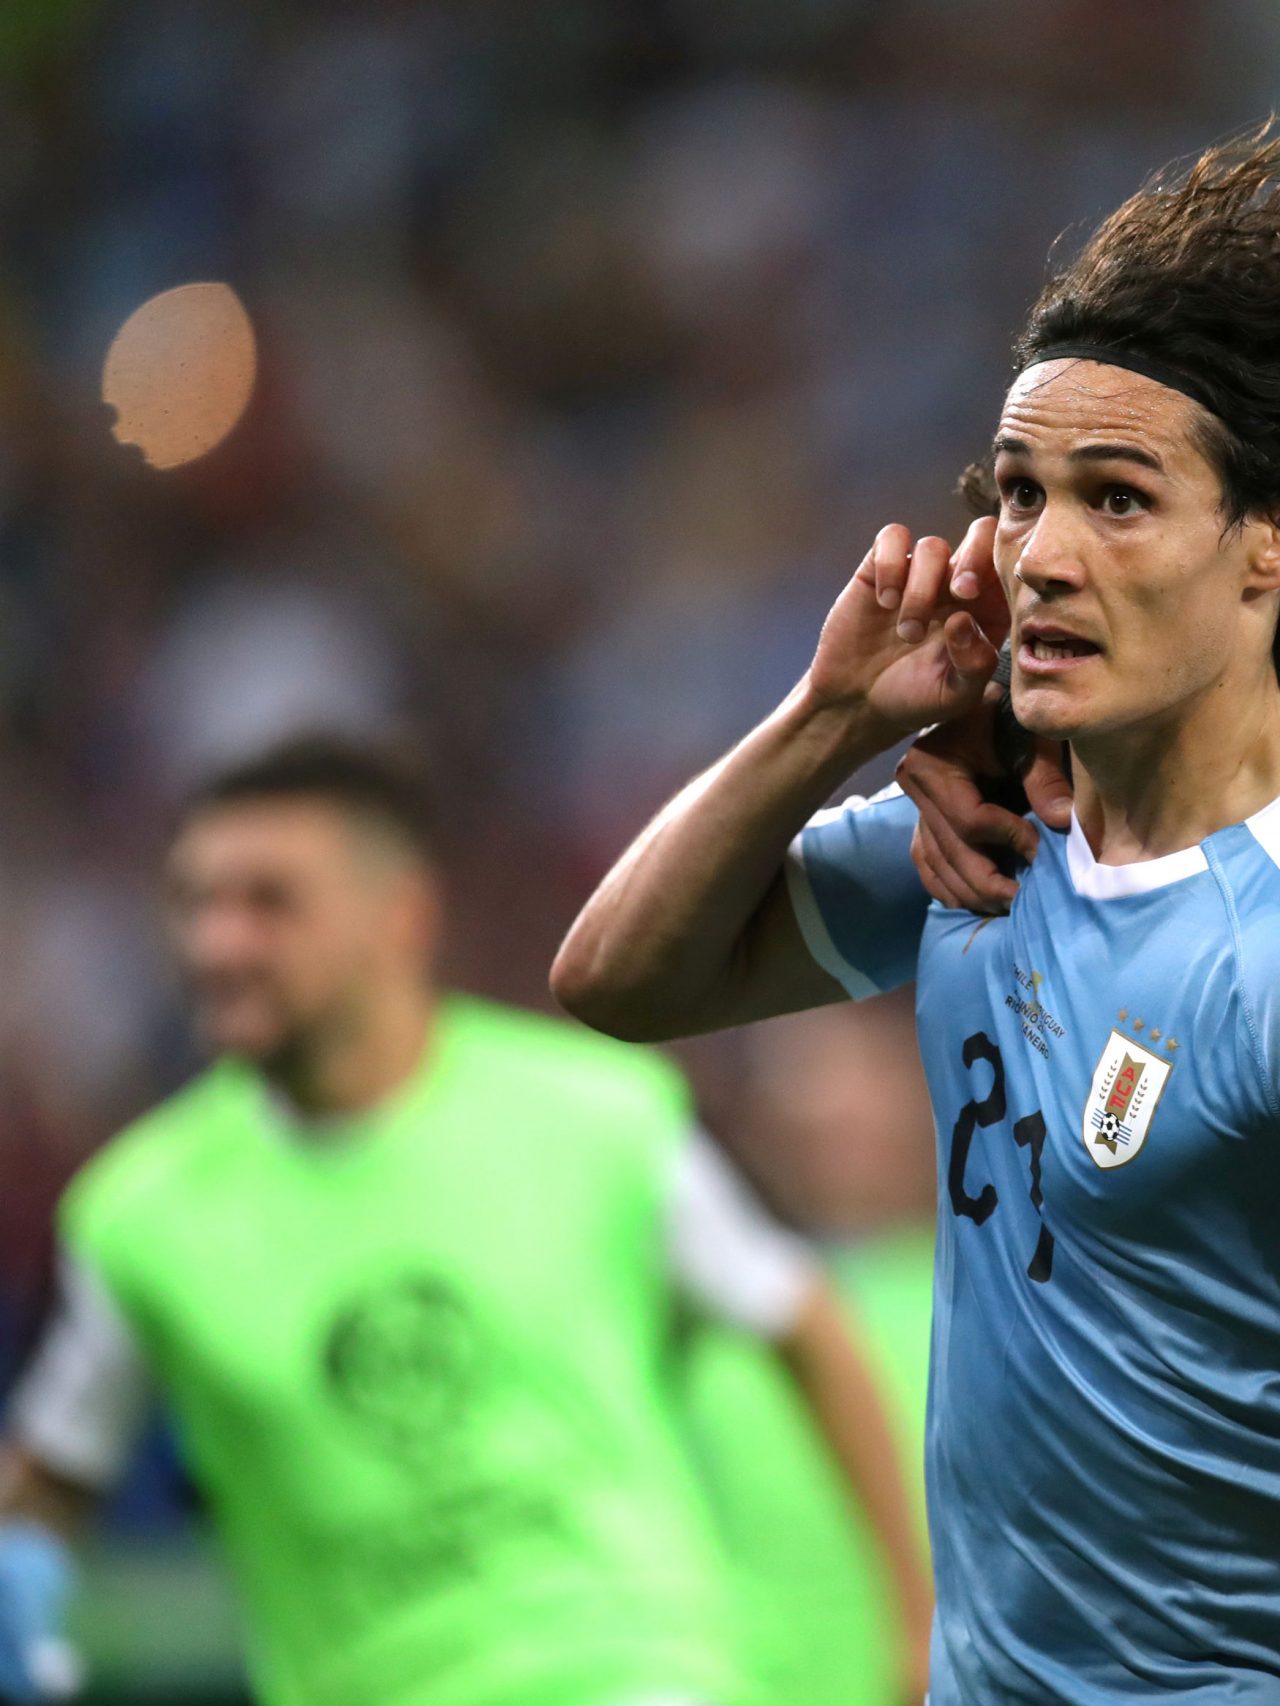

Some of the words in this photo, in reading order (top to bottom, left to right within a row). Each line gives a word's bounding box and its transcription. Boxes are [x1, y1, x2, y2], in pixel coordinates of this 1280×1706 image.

[1022, 1022, 1049, 1060] ANEIRO
[1108, 1066, 1136, 1110] AUF
[948, 1031, 1055, 1283] 21
